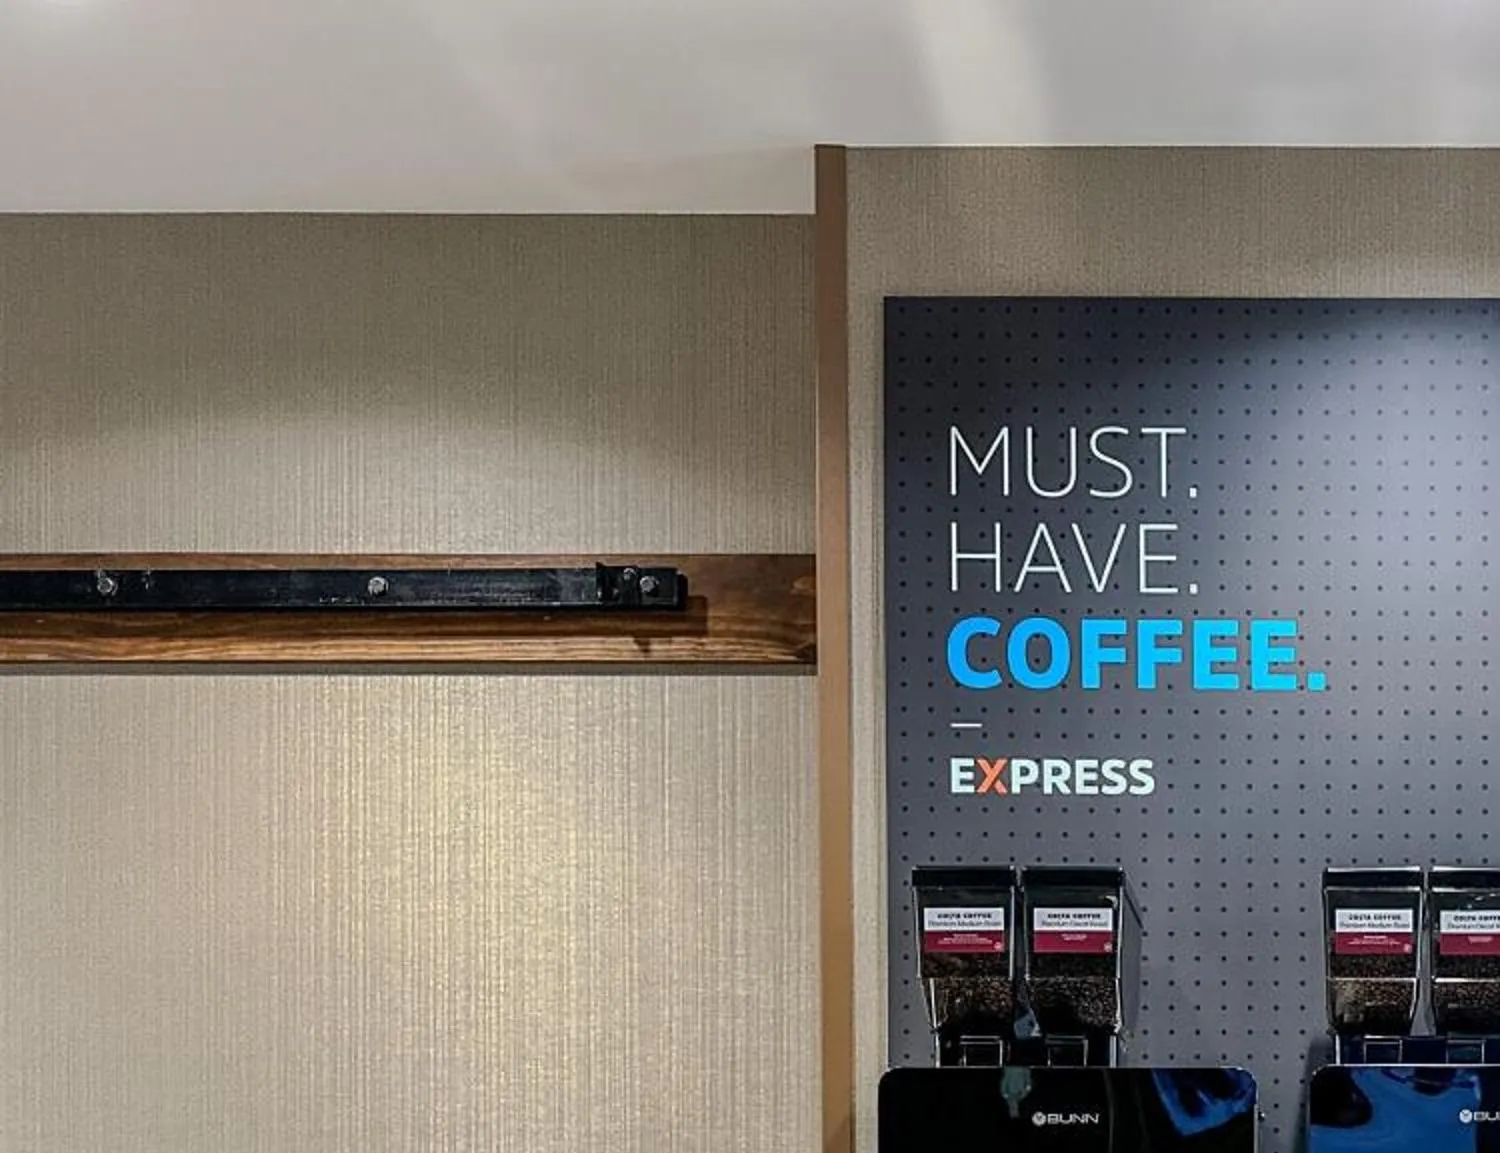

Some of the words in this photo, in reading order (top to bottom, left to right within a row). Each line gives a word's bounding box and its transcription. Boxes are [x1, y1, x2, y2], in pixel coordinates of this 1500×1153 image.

[949, 424, 1199, 499] MUST.
[950, 521, 1199, 594] HAVE.
[946, 615, 1328, 691] COFFEE.
[950, 757, 1156, 796] EXPRESS
[1047, 1112, 1100, 1125] BUNN
